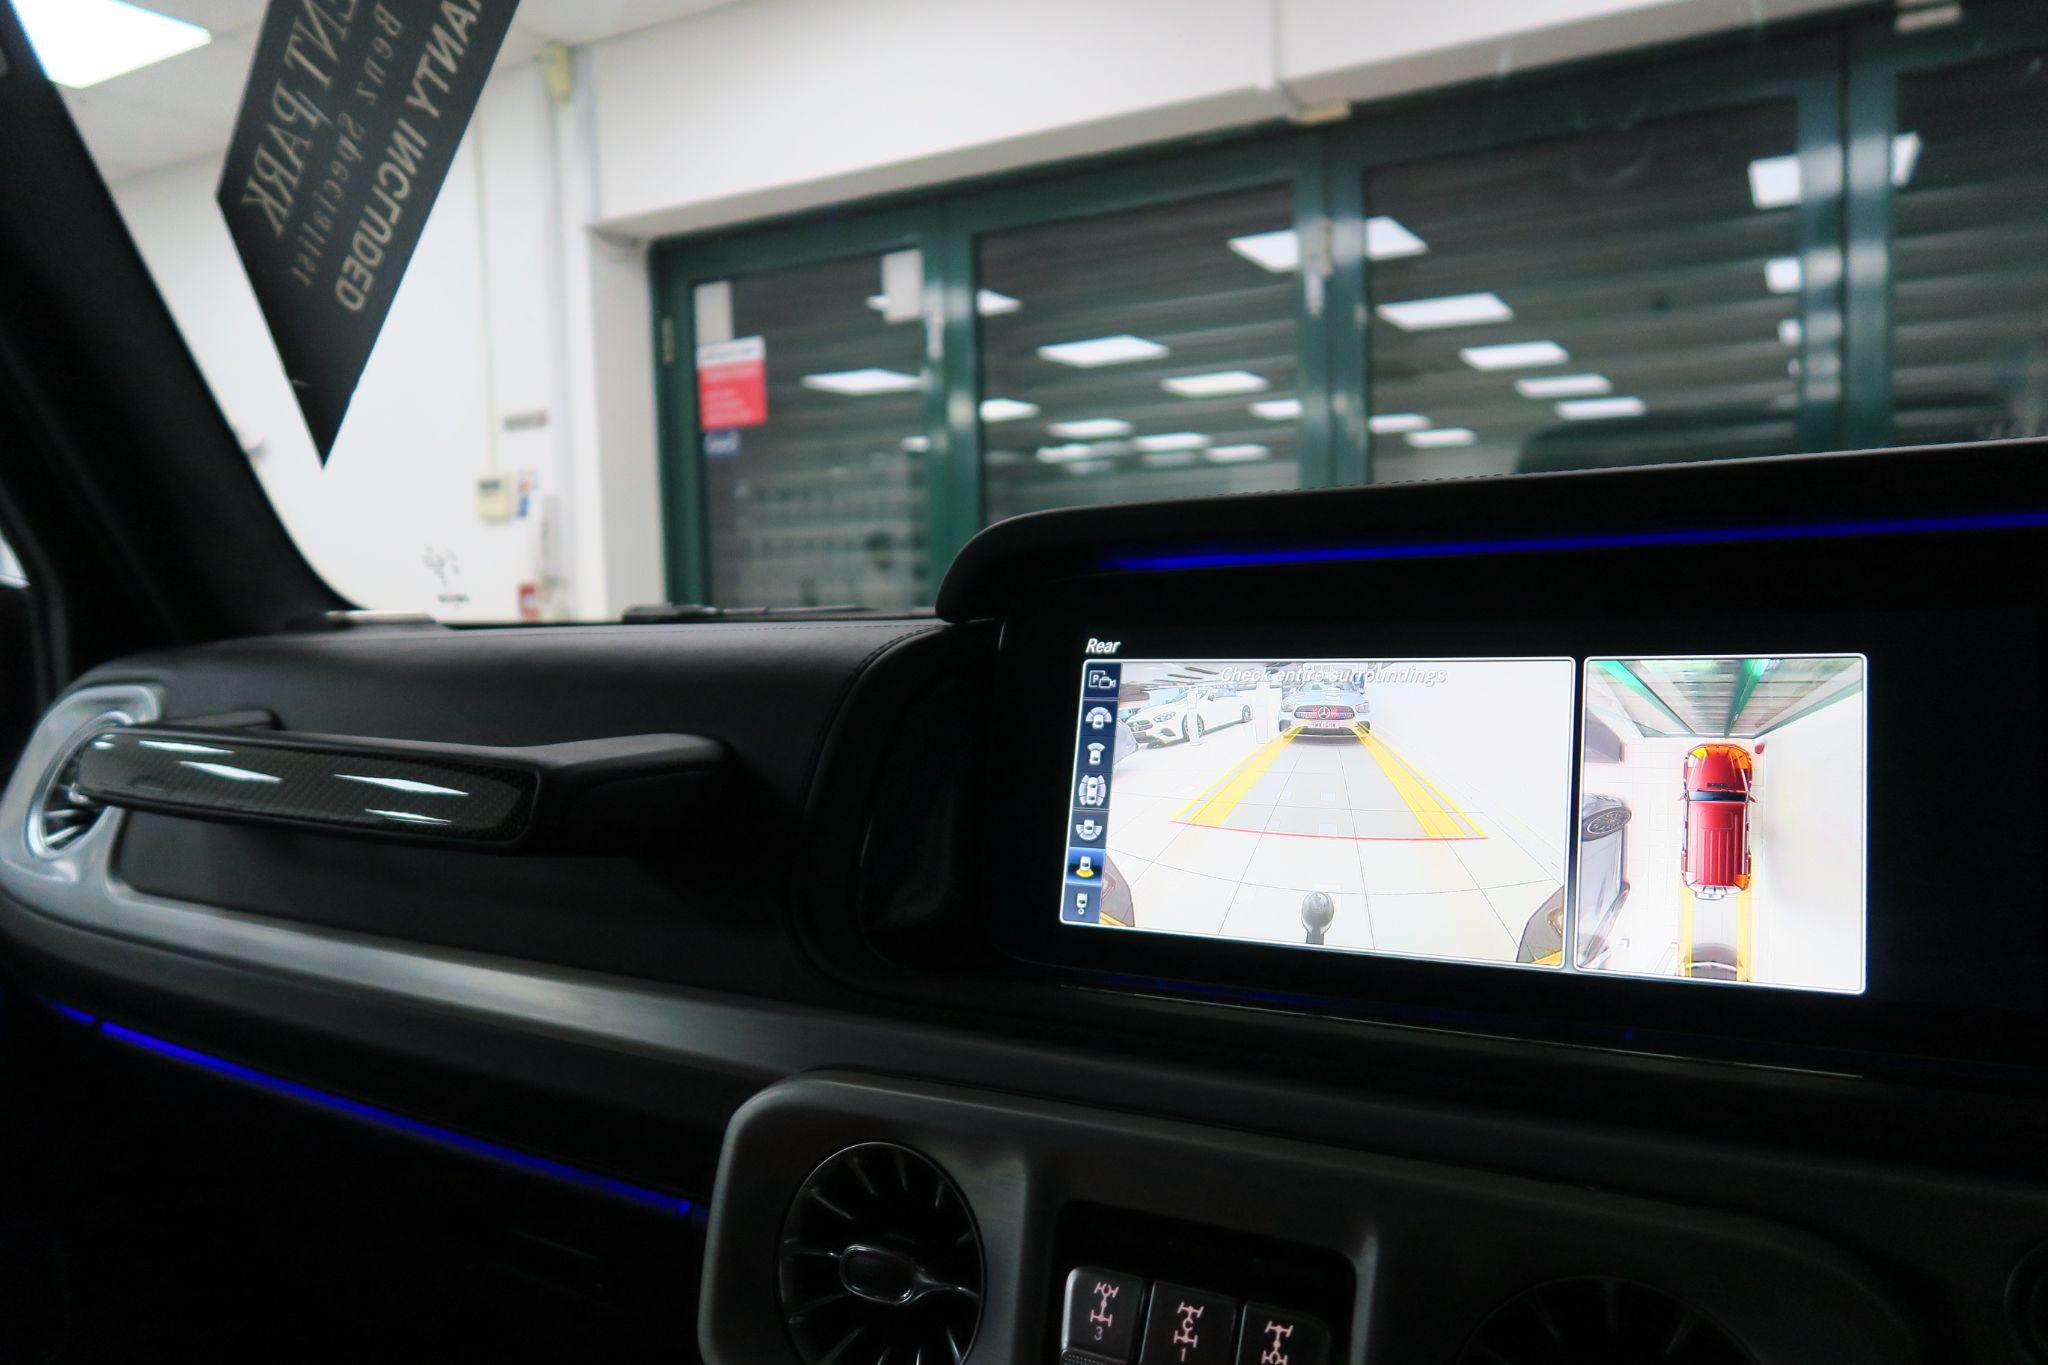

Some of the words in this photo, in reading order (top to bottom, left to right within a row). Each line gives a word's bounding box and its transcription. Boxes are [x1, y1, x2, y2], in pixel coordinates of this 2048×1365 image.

[1085, 637, 1121, 654] Rear
[1220, 666, 1273, 682] Check
[1275, 667, 1325, 682] entire
[1329, 664, 1448, 688] surroundings
[1094, 1326, 1104, 1341] 3
[1180, 1347, 1187, 1363] 1
